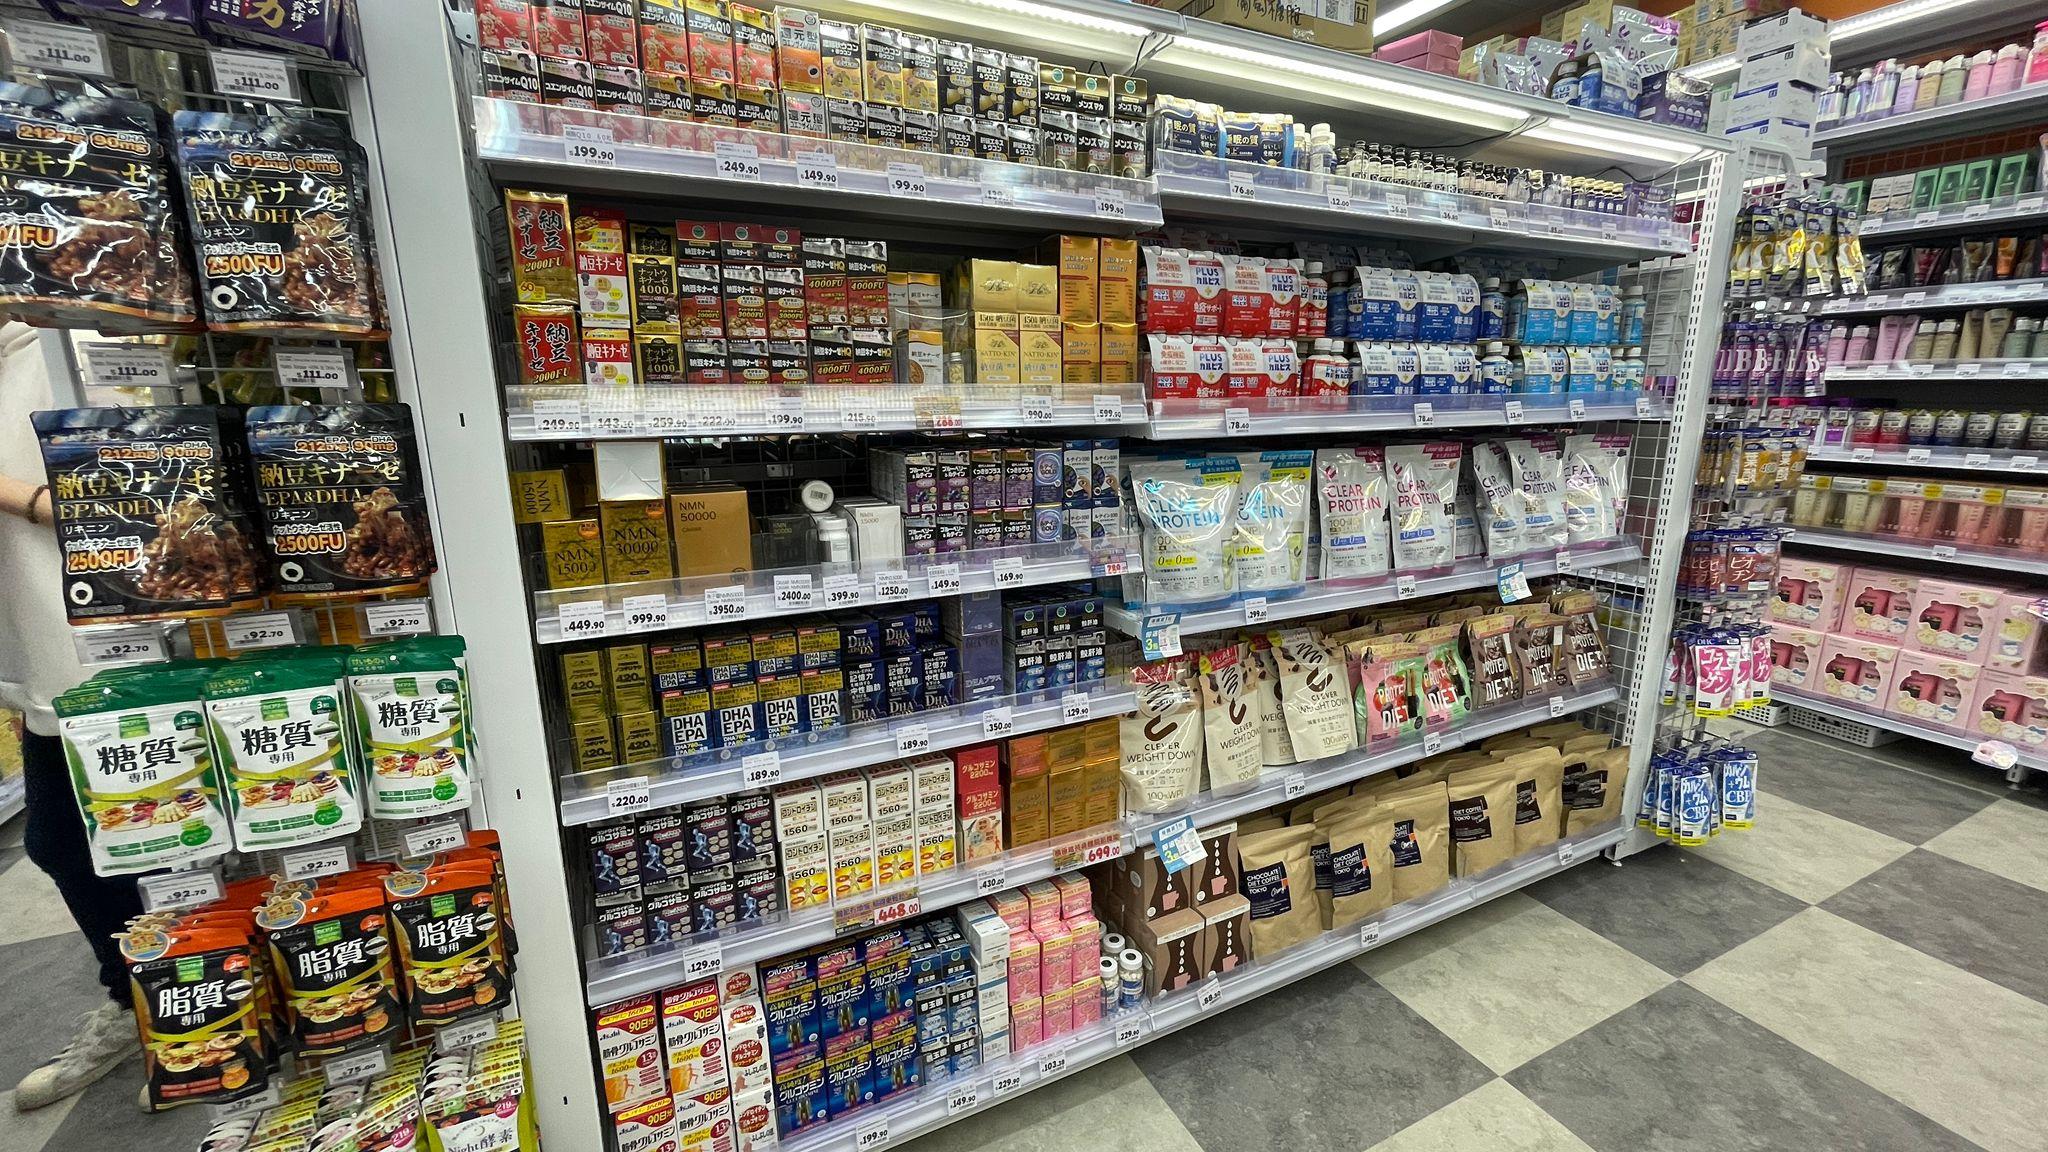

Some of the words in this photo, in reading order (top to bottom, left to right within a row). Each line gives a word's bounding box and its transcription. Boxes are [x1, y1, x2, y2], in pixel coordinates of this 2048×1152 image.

[517, 209, 536, 260] キナーゼ
[538, 210, 565, 252] 納豆
[1196, 267, 1219, 276] PLUS
[809, 279, 843, 288] 4000FU
[1272, 275, 1293, 284] PLUS
[639, 284, 669, 295] 4000
[525, 323, 544, 372] キナーゼ
[545, 323, 571, 363] 納豆
[1200, 353, 1223, 362] PLUS
[1269, 354, 1291, 363] PLUS
[648, 364, 676, 374] 4000
[298, 440, 350, 453] 212mg
[260, 461, 400, 486] 納豆キナーゼ
[265, 488, 363, 505] EPA&DHA
[679, 501, 705, 512] NMN
[680, 510, 717, 522] 50000
[615, 526, 657, 540] NMN
[888, 666, 912, 674] 記憶力
[925, 661, 947, 669] 記憶力
[850, 672, 874, 682] 記憶力
[378, 698, 440, 728] 糖質
[768, 701, 794, 715] DHA
[812, 704, 839, 717] EPA
[722, 708, 751, 722] DHA
[768, 712, 796, 726] EPA
[673, 716, 704, 730] DHA
[724, 720, 752, 735] EPA
[1233, 722, 1253, 734] CLEVER
[400, 726, 421, 737] 専用
[675, 728, 706, 743] EPA
[242, 720, 317, 757] 糖質
[1220, 734, 1247, 750] WEIGHT
[97, 736, 181, 775] 糖質
[269, 750, 295, 763] 専用
[1127, 752, 1165, 763] WEIGHT
[128, 770, 157, 783] 専用
[1333, 851, 1359, 863] CHOCOLATE
[1333, 860, 1345, 868] DIET
[1247, 868, 1280, 882] CHOCOLATE
[1248, 879, 1260, 887] DIET
[418, 913, 476, 948] 脂質
[437, 943, 460, 955] 専用
[299, 940, 367, 978] 脂質
[323, 969, 347, 983] 専用
[159, 982, 227, 1018] 脂質
[180, 1014, 205, 1026] 専用
[693, 1007, 719, 1020] 90日分
[668, 1023, 721, 1046] 筋骨グルコサミン
[602, 1033, 657, 1058] 筋骨グルコサミン
